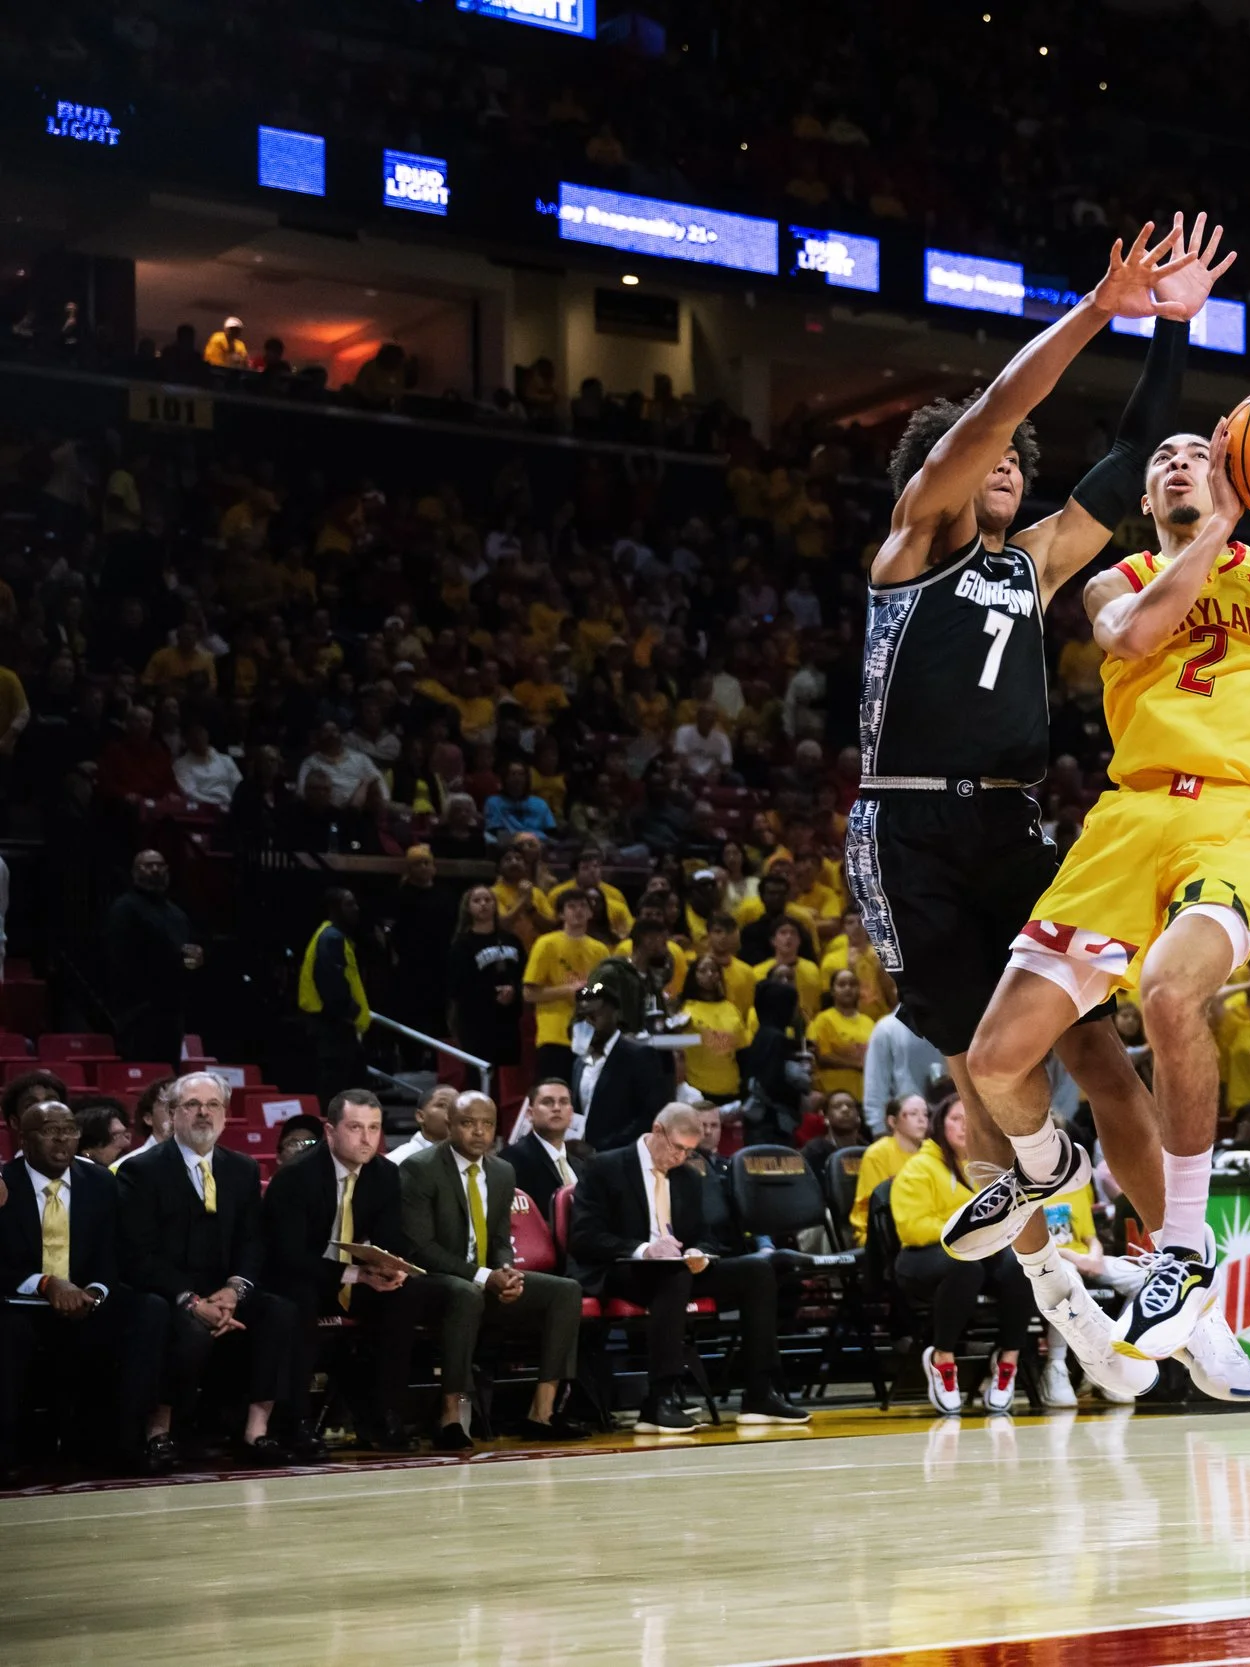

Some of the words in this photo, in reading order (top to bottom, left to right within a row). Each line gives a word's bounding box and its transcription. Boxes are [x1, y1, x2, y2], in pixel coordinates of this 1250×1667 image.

[57, 100, 112, 126] BUD
[46, 115, 121, 145] LIGHT
[394, 164, 445, 187] BUD
[386, 177, 451, 205] LIGHT
[804, 238, 848, 261] BUD
[797, 250, 855, 277] LIGHT
[978, 608, 1015, 691] 7
[1176, 623, 1228, 697] 2
[1176, 774, 1197, 794] M
